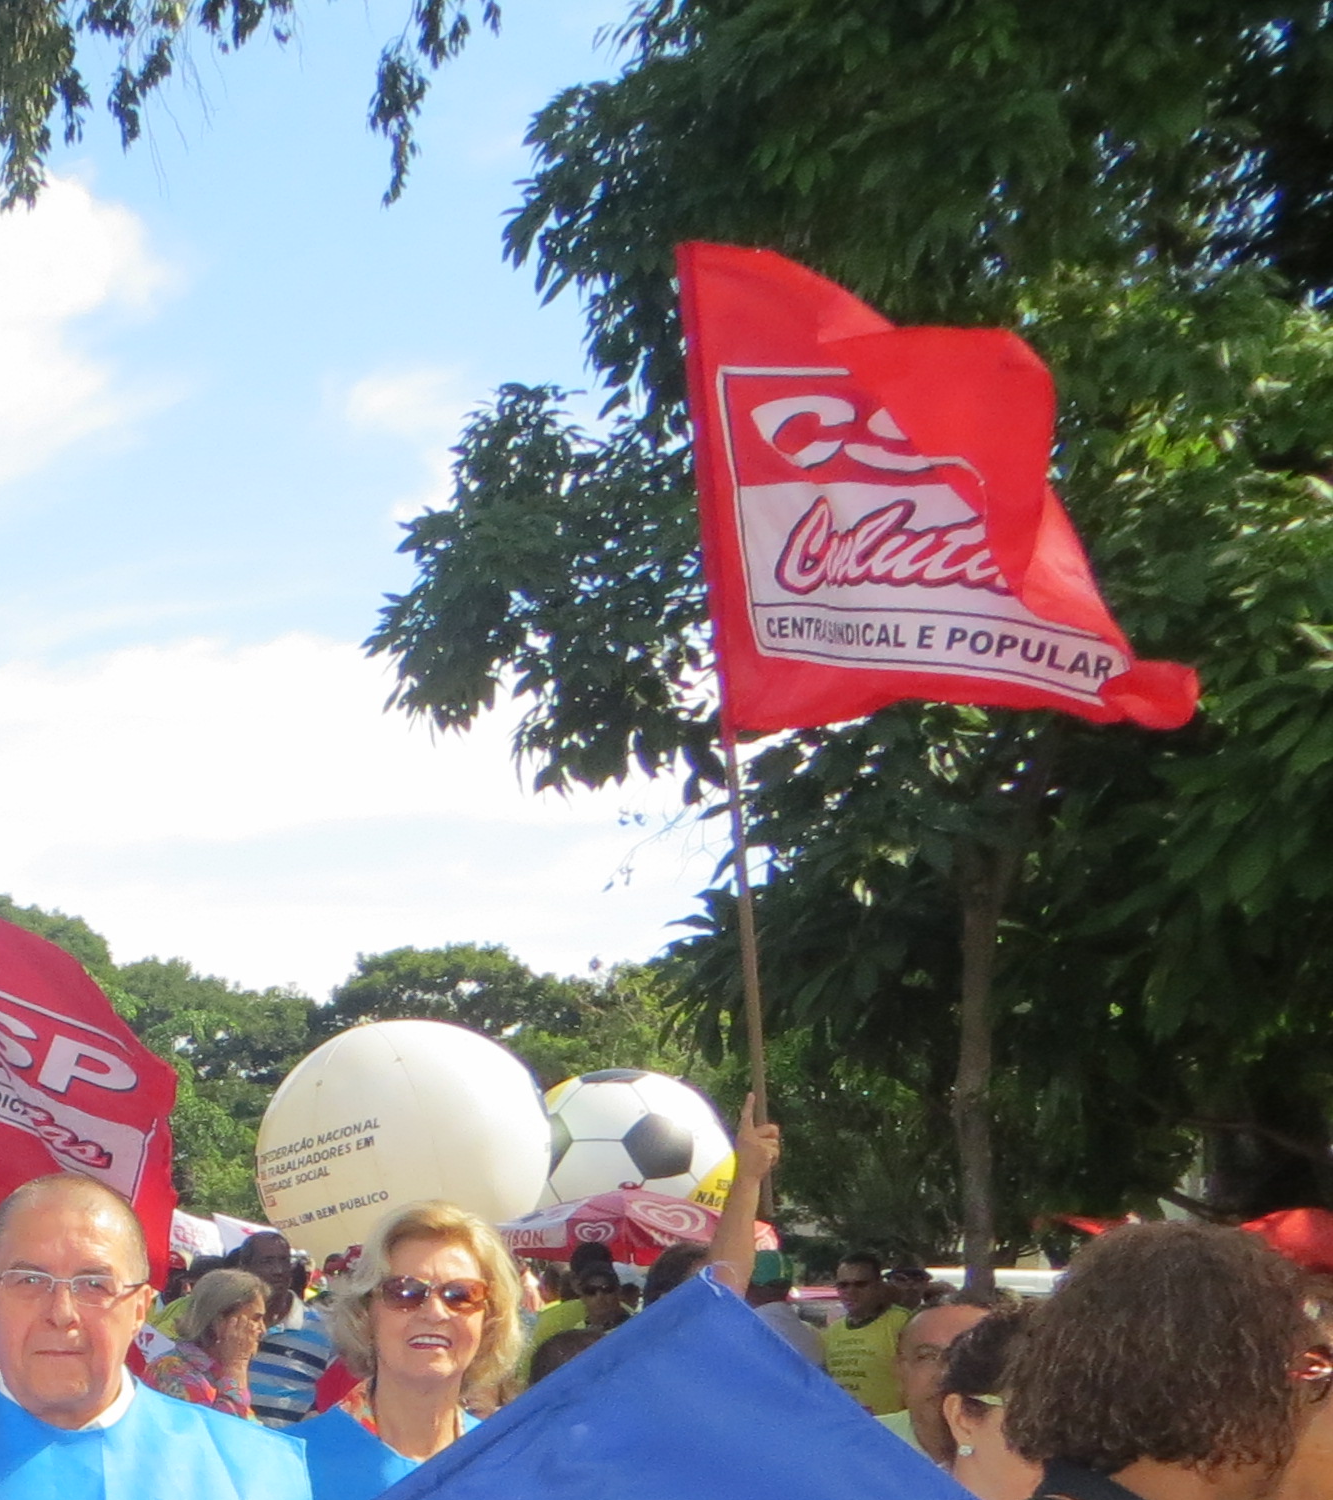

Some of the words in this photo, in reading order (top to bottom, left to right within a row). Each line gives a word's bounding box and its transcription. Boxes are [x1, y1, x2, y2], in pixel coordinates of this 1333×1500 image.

[917, 625, 935, 649] E
[945, 629, 1114, 681] POPULAR
[317, 1117, 381, 1146] NACIONAL
[356, 1135, 376, 1151] EM
[295, 1166, 331, 1186] SOCIAL
[316, 1205, 338, 1220] BEM
